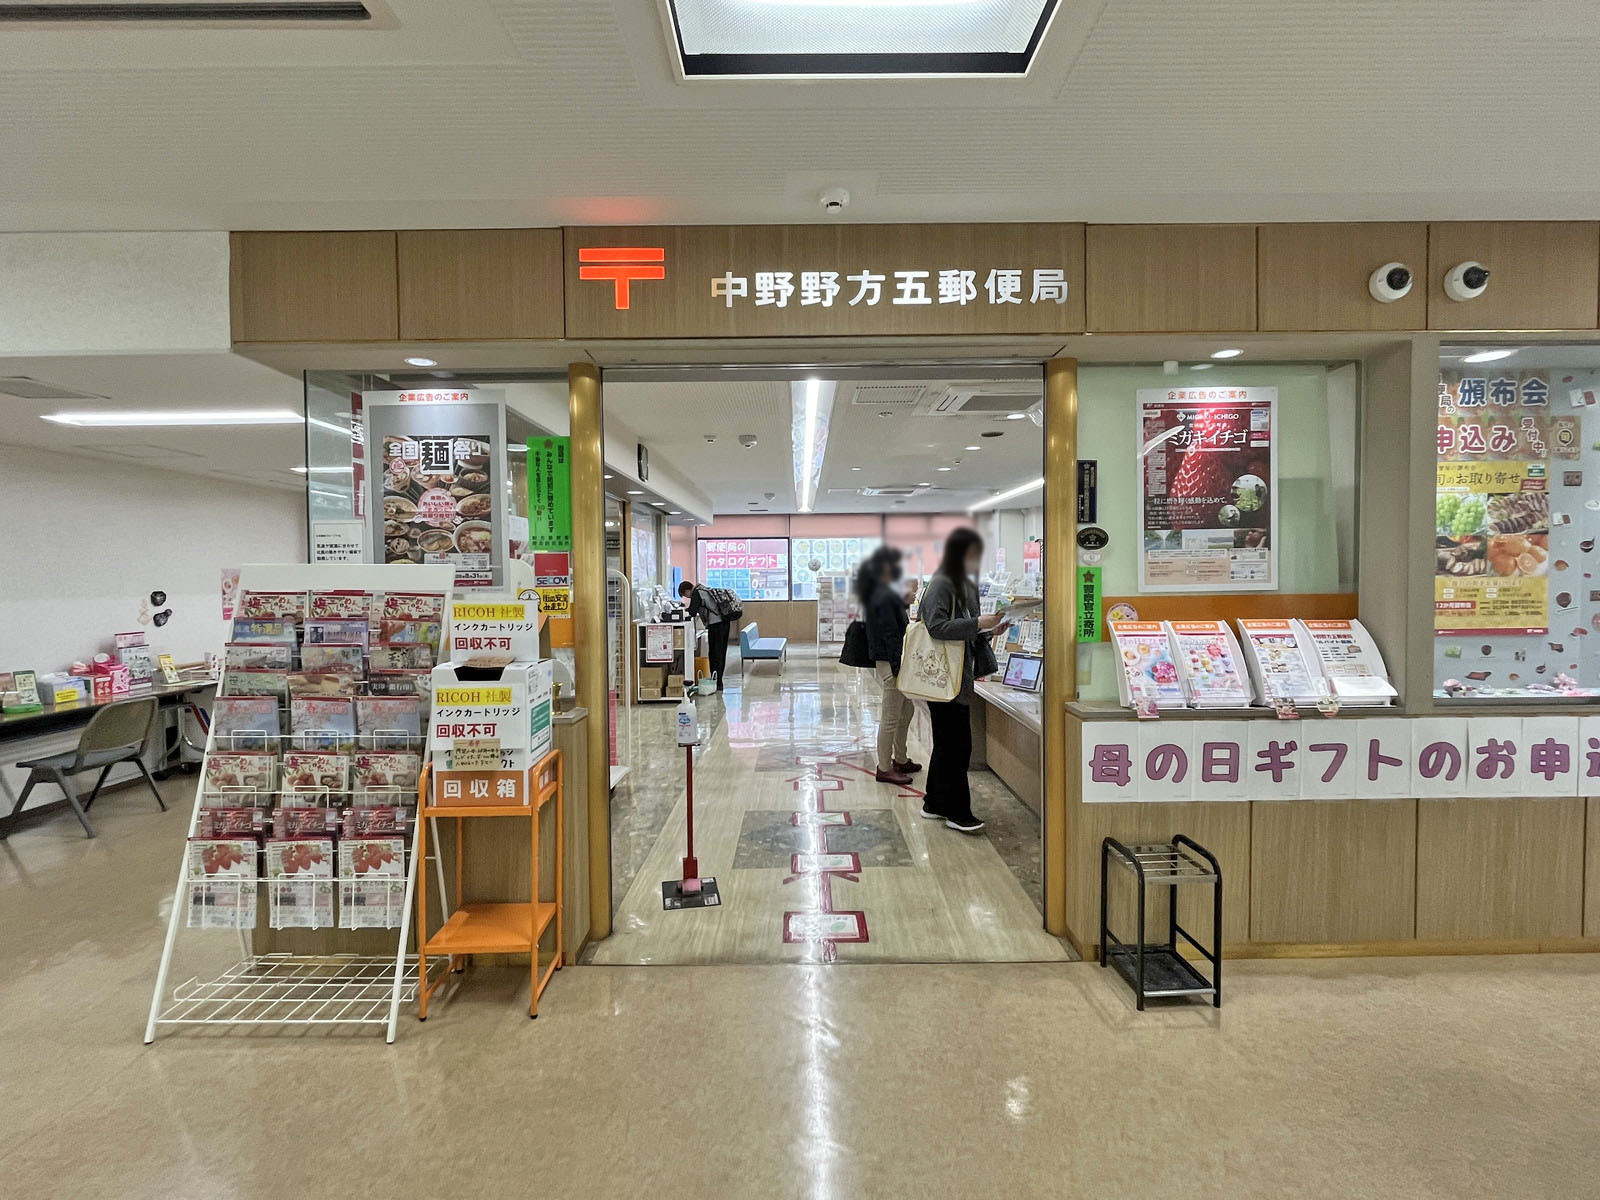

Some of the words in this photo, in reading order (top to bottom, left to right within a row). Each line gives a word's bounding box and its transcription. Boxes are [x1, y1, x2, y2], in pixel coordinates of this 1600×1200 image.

[711, 268, 1069, 308] 中野野方五郵便局
[398, 392, 470, 402] 企業広告のご案内
[1167, 390, 1248, 399] 企業広告のご案内
[1459, 378, 1549, 406] 頒布会
[1168, 429, 1249, 446] ミガキイチゴ
[389, 439, 482, 475] 全国麺祭り
[706, 542, 746, 553] 郵便局の
[707, 556, 777, 567] カタログギフト
[536, 577, 568, 585] SECOM
[453, 606, 496, 618] RICOH
[500, 605, 525, 617] 社製
[1082, 584, 1095, 638] 警察官立寄所
[454, 623, 534, 632] インクカートリッジ
[454, 637, 512, 651] 回収不可
[436, 691, 481, 703] RICOH
[485, 690, 512, 703] 社製
[436, 707, 521, 718] インクカートリッジ
[436, 723, 497, 738] 回収不可
[443, 780, 517, 799] 回収箱
